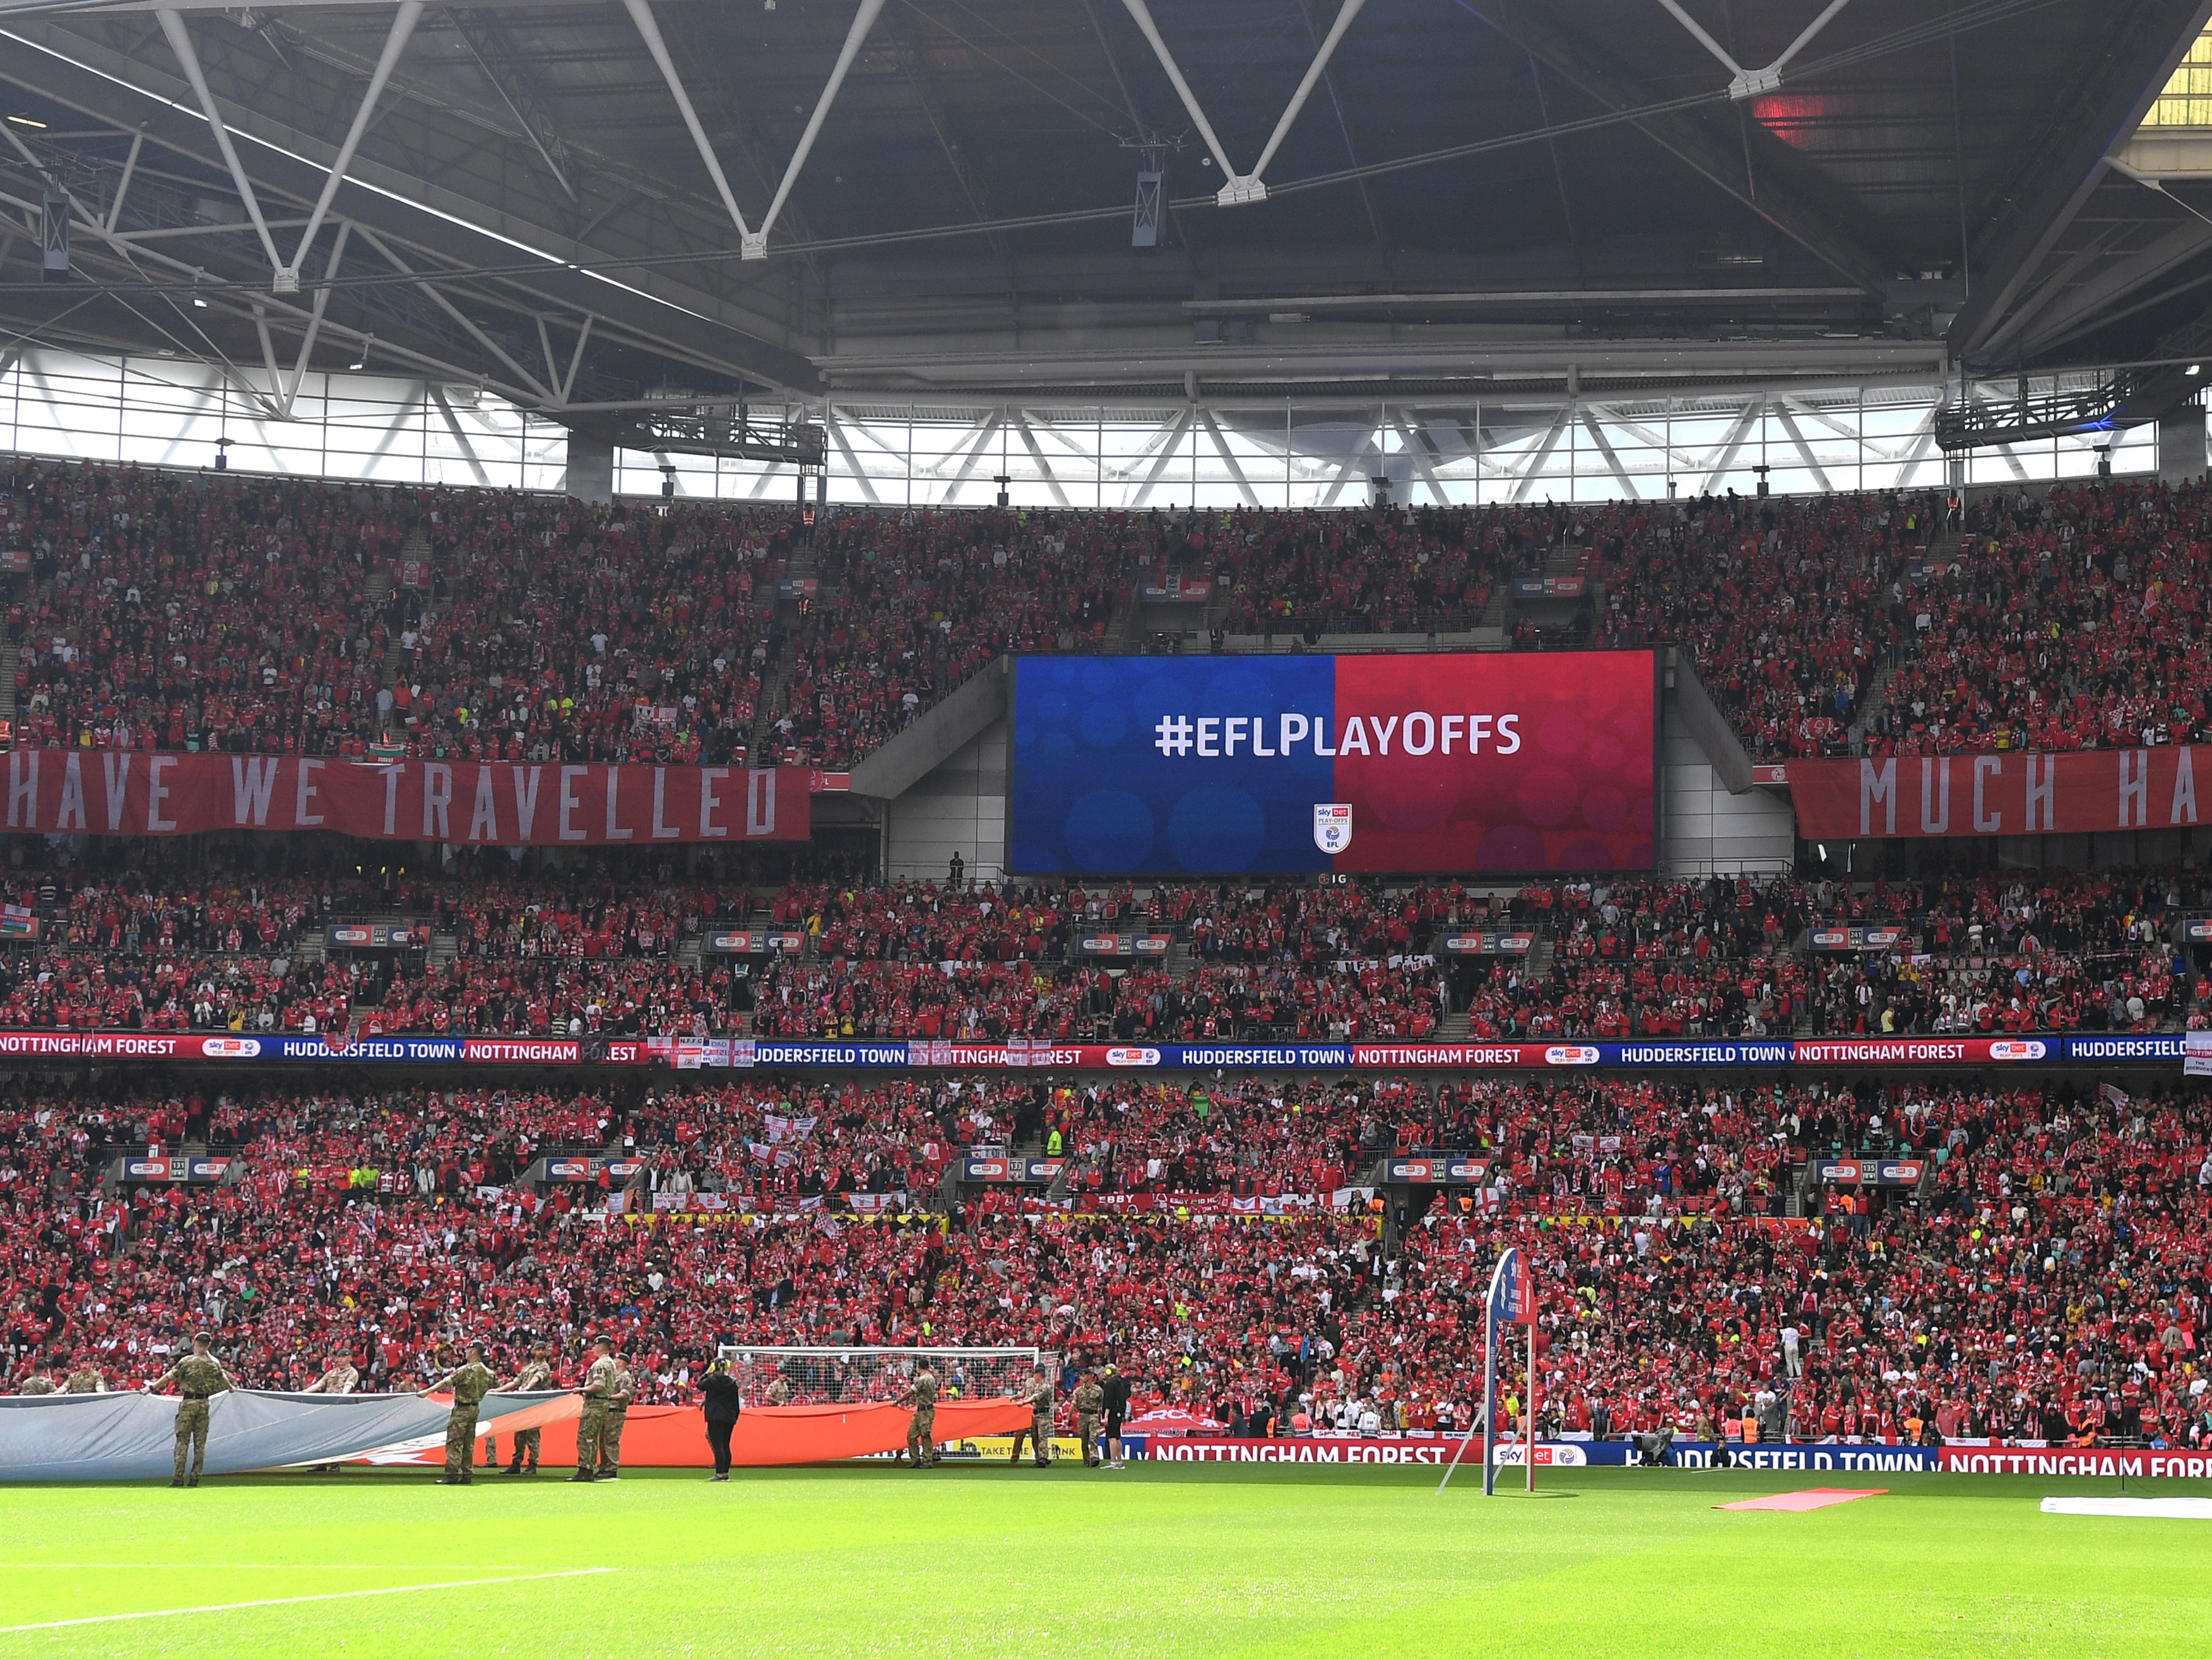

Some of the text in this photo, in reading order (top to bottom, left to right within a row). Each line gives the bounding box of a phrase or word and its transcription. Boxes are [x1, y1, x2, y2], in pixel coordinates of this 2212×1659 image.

[7, 751, 776, 841] HAVE WE TRAVELLED
[1860, 754, 2055, 835] MUCH
[0, 1037, 176, 1054] NOTTINGHAM FOREST
[208, 1041, 223, 1050] sky
[408, 1044, 455, 1059] TOWN
[470, 1045, 577, 1061] NOTTINGHAM
[1621, 1047, 1736, 1062] HUDDERSFIELD
[1739, 1046, 1785, 1061] TOWN
[1799, 1045, 1905, 1061] NOTTINGHAM
[1908, 1044, 1965, 1059] FOREST
[1996, 1043, 2026, 1053] sky bet
[859, 1049, 904, 1063] TOWN
[1112, 1050, 1125, 1059] sky
[1182, 1049, 1296, 1064] HUDDERSFIELD
[1299, 1049, 1345, 1064] TOWN
[1359, 1049, 1462, 1064] NOTTINGHAM
[1465, 1049, 1520, 1064] FOREST
[1551, 1049, 1564, 1058] sky
[981, 1447, 1005, 1456] TAKE
[1156, 1445, 1339, 1463] NOTTINGHAM
[1347, 1446, 1446, 1463] FOREST
[1499, 1451, 1522, 1463] sky
[1839, 1451, 1923, 1472] TOWN
[1951, 1453, 2143, 1476] NOTTINGHAM
